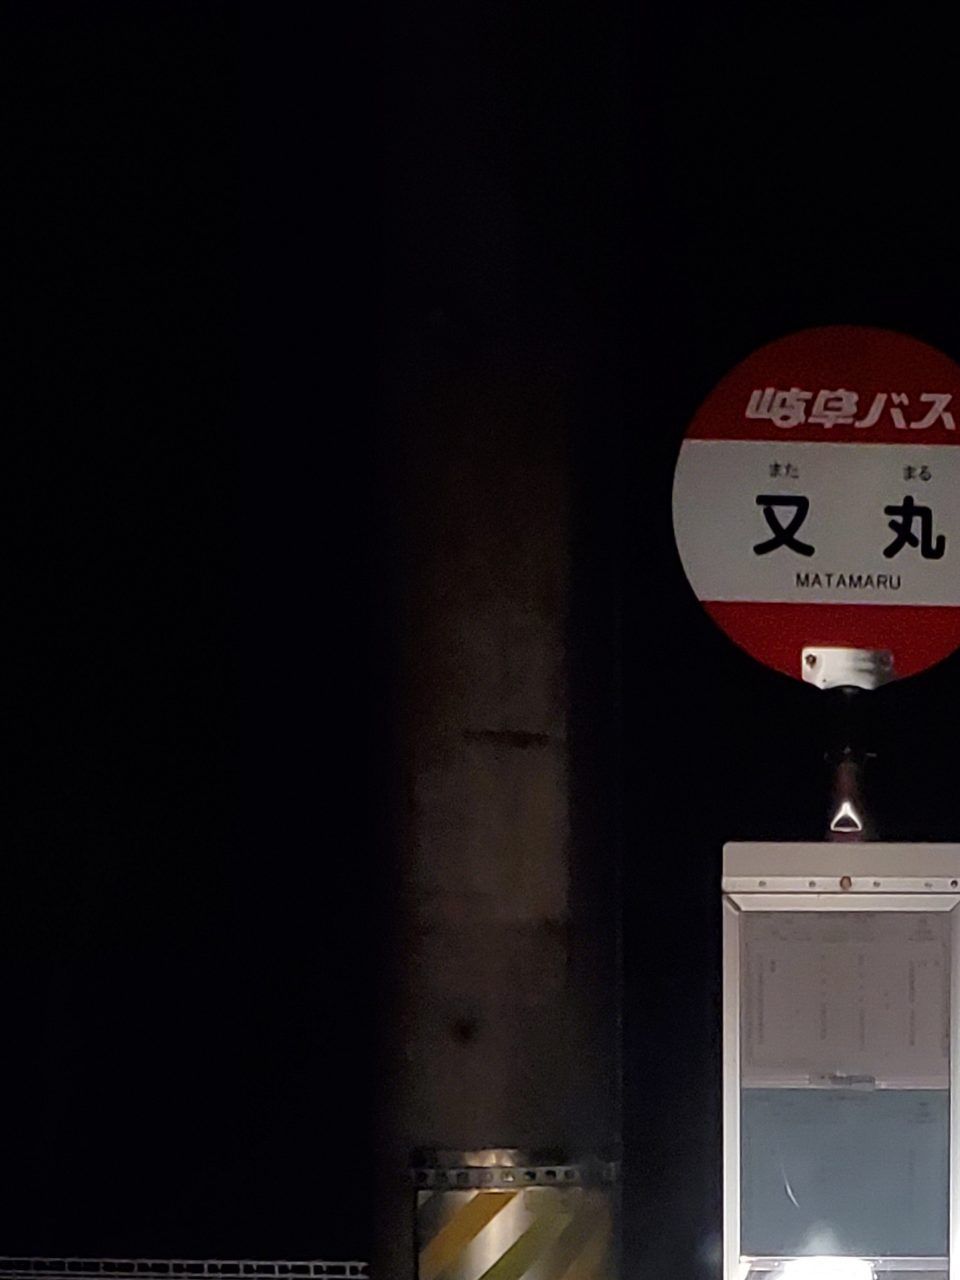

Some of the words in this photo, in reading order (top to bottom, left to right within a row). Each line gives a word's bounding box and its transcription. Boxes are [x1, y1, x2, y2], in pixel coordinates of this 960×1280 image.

[745, 386, 957, 431] 岐阜バス
[769, 463, 800, 480] また
[903, 464, 932, 482] まる
[795, 572, 901, 591] MATAMARU
